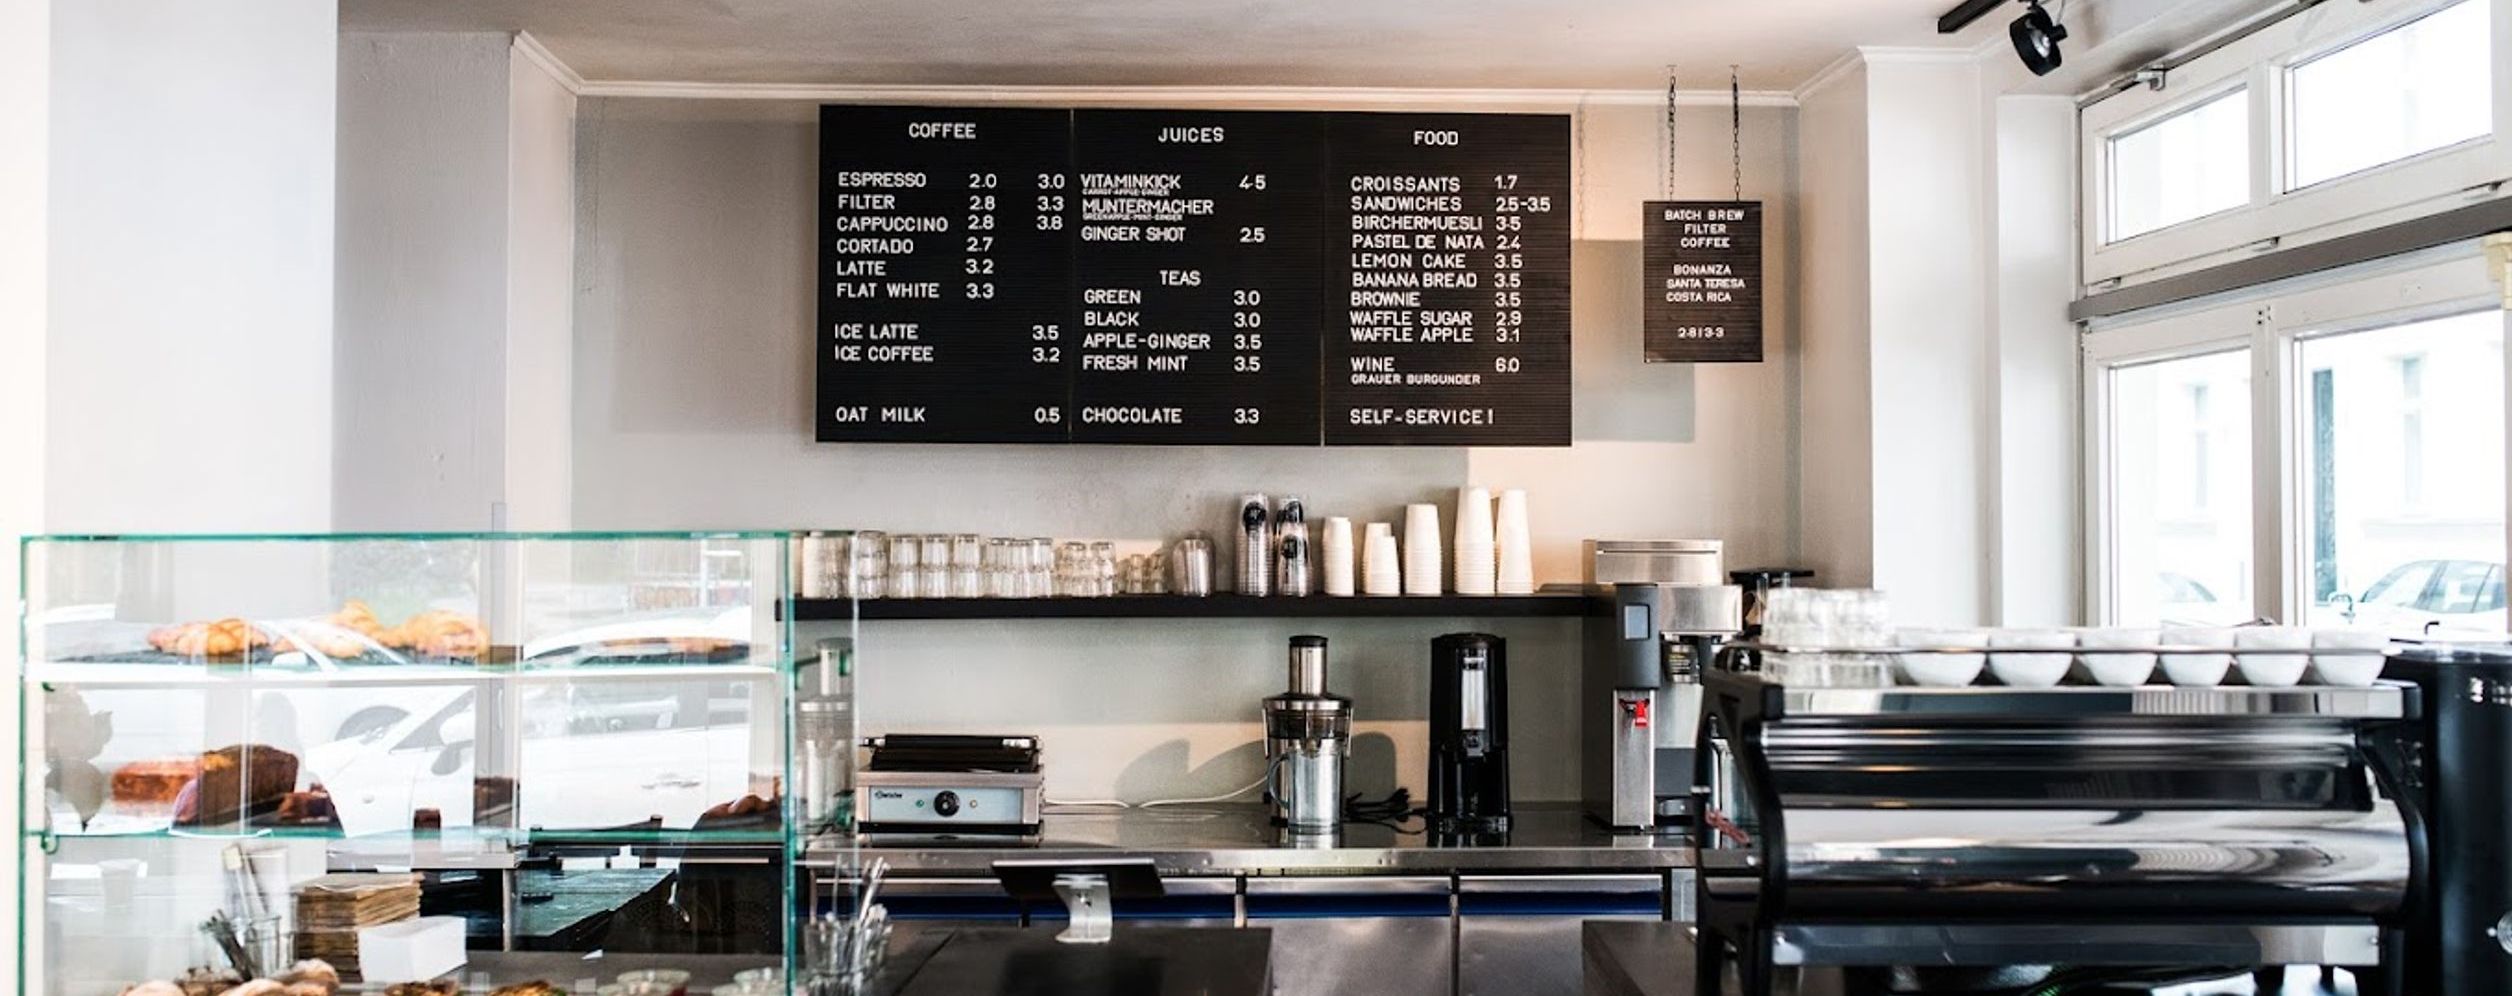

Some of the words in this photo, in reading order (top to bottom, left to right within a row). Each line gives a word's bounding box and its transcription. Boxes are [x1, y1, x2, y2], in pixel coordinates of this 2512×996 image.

[909, 123, 975, 138] COFFEE
[1158, 127, 1223, 142] JUICES
[1415, 131, 1458, 145] FOOD
[839, 172, 926, 187] ESPRESSO
[970, 174, 996, 188] 2.0
[1038, 174, 1064, 189] 3.0
[1080, 174, 1181, 189] VITAMINKICK
[1351, 176, 1460, 192] CROISSANTS
[1495, 175, 1517, 189] 1.7
[839, 194, 895, 209] FILTER
[970, 196, 995, 210] 2.8
[1038, 196, 1064, 211] 3.3
[1082, 199, 1214, 214] MUNTERMACHER
[1352, 196, 1461, 211] SANDWICHES
[1352, 215, 1482, 230] BIRCHERMUESLI
[1665, 210, 1701, 220] BATCH
[1708, 210, 1744, 220] BREW
[837, 217, 948, 231] CAPPUCCINO
[968, 215, 994, 229] 2.8
[1037, 215, 1062, 230] 3.8
[1685, 224, 1726, 234] FILTER
[1082, 226, 1140, 240] GINGER
[1146, 227, 1186, 241] SHOT
[1240, 228, 1265, 242] 2.5
[837, 239, 913, 253] CORTADO
[967, 237, 993, 251] 2.7
[1353, 235, 1410, 248] PASTEL
[1416, 235, 1436, 249] DE
[1446, 235, 1484, 249] NATA
[1497, 235, 1521, 249] 2.4
[1681, 237, 1729, 247] COFFEE
[837, 261, 885, 275] LATTE
[966, 259, 993, 274] 3.2
[1352, 253, 1412, 268] LEMON
[1423, 254, 1465, 268] CAKE
[1495, 254, 1522, 268] 3.5
[1674, 265, 1731, 275] BONANZA
[1160, 271, 1201, 286] TEAS
[1353, 273, 1419, 287] BANANA
[1423, 273, 1477, 287] BREAD
[1495, 273, 1520, 288] 3.5
[1667, 279, 1701, 288] SANTA
[1705, 279, 1745, 288] TERESA
[837, 283, 876, 297] FLAT
[887, 283, 939, 298] WHITE
[967, 283, 993, 298] 3.3
[1085, 289, 1140, 304] GREEN
[1234, 290, 1260, 305] 3.0
[1666, 292, 1703, 302] COSTA
[1707, 292, 1731, 301] RICA
[1351, 292, 1420, 306] BROWNIE
[1495, 292, 1521, 307] 3.5
[1085, 312, 1139, 326] BLACK
[1234, 312, 1260, 327] 3.0
[1350, 311, 1412, 325] WAFFLE
[1421, 311, 1472, 325] SUGAR
[1497, 311, 1521, 326] 2.9
[835, 324, 862, 339] ICE
[870, 324, 918, 339] LATTE
[1033, 325, 1058, 340] 3.5
[1351, 327, 1413, 342] WAFFLE
[1421, 327, 1473, 342] APPLE
[1497, 327, 1519, 342] 3.1
[1083, 334, 1210, 349] APPLE-GINGER
[1235, 334, 1262, 349] 3.5
[835, 346, 861, 361] ICE
[868, 346, 933, 361] COFFEE
[1033, 347, 1060, 362] 3.2
[1083, 355, 1137, 370] FRESH
[1148, 356, 1188, 370] MINT
[1235, 356, 1260, 371] 3.5
[1351, 357, 1394, 372] WINE
[1496, 357, 1519, 372] 6.0
[1351, 374, 1401, 384] GRAUER
[1407, 374, 1480, 384] BURGUNDER
[836, 407, 867, 421] OAT
[882, 408, 924, 422] MILK
[1035, 408, 1060, 423] 0.5
[1083, 407, 1181, 423] CHOCOLATE
[1235, 409, 1259, 423] 3.3
